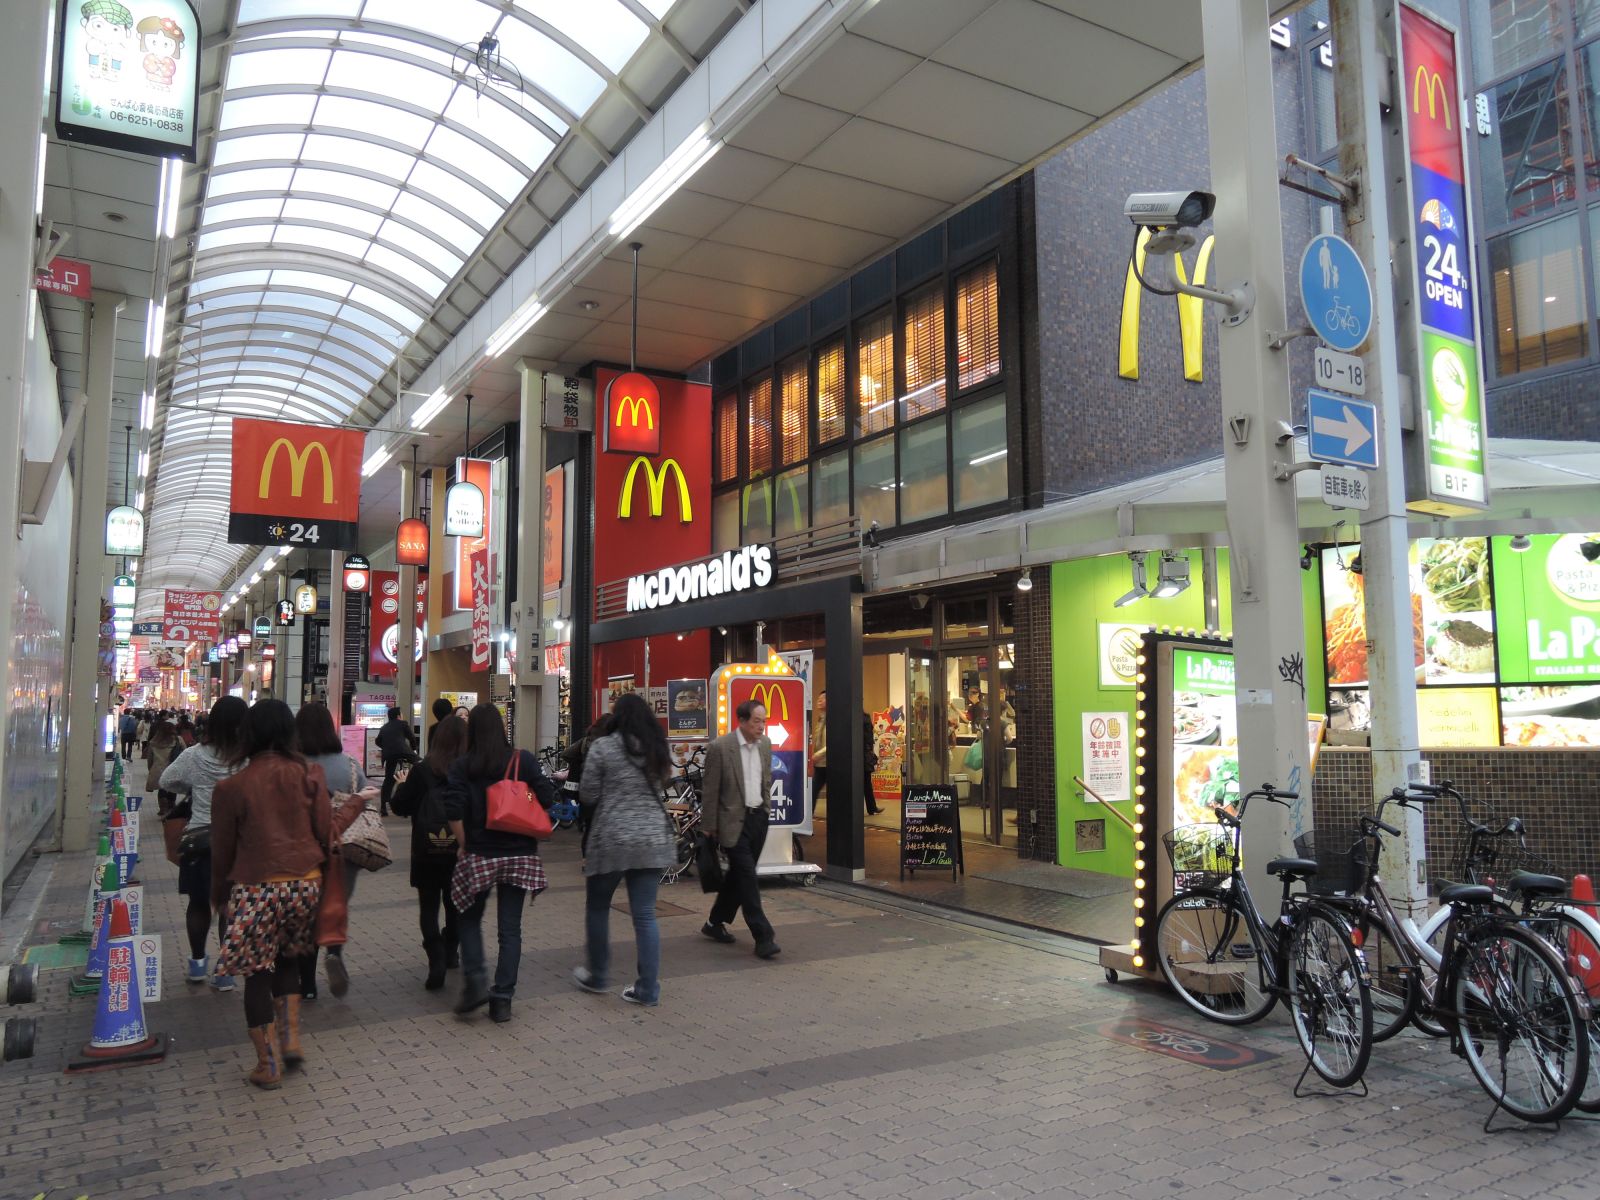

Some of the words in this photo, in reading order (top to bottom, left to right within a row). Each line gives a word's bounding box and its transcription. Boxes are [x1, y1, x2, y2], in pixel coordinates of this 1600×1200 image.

[109, 110, 184, 133] 06-6251-0838
[1425, 279, 1463, 310] OPEN
[1324, 474, 1367, 501] 自転車を除く
[1445, 473, 1468, 493] B1F
[289, 523, 320, 543] 24
[399, 541, 425, 550] SANA
[626, 543, 773, 612] McDonald's
[1556, 569, 1593, 580] Pasta
[1112, 655, 1128, 663] Pasta
[1092, 750, 1120, 759] 実施中
[906, 790, 931, 802] Lunch
[931, 790, 951, 802] Menu
[144, 956, 158, 998] 駐輪禁止
